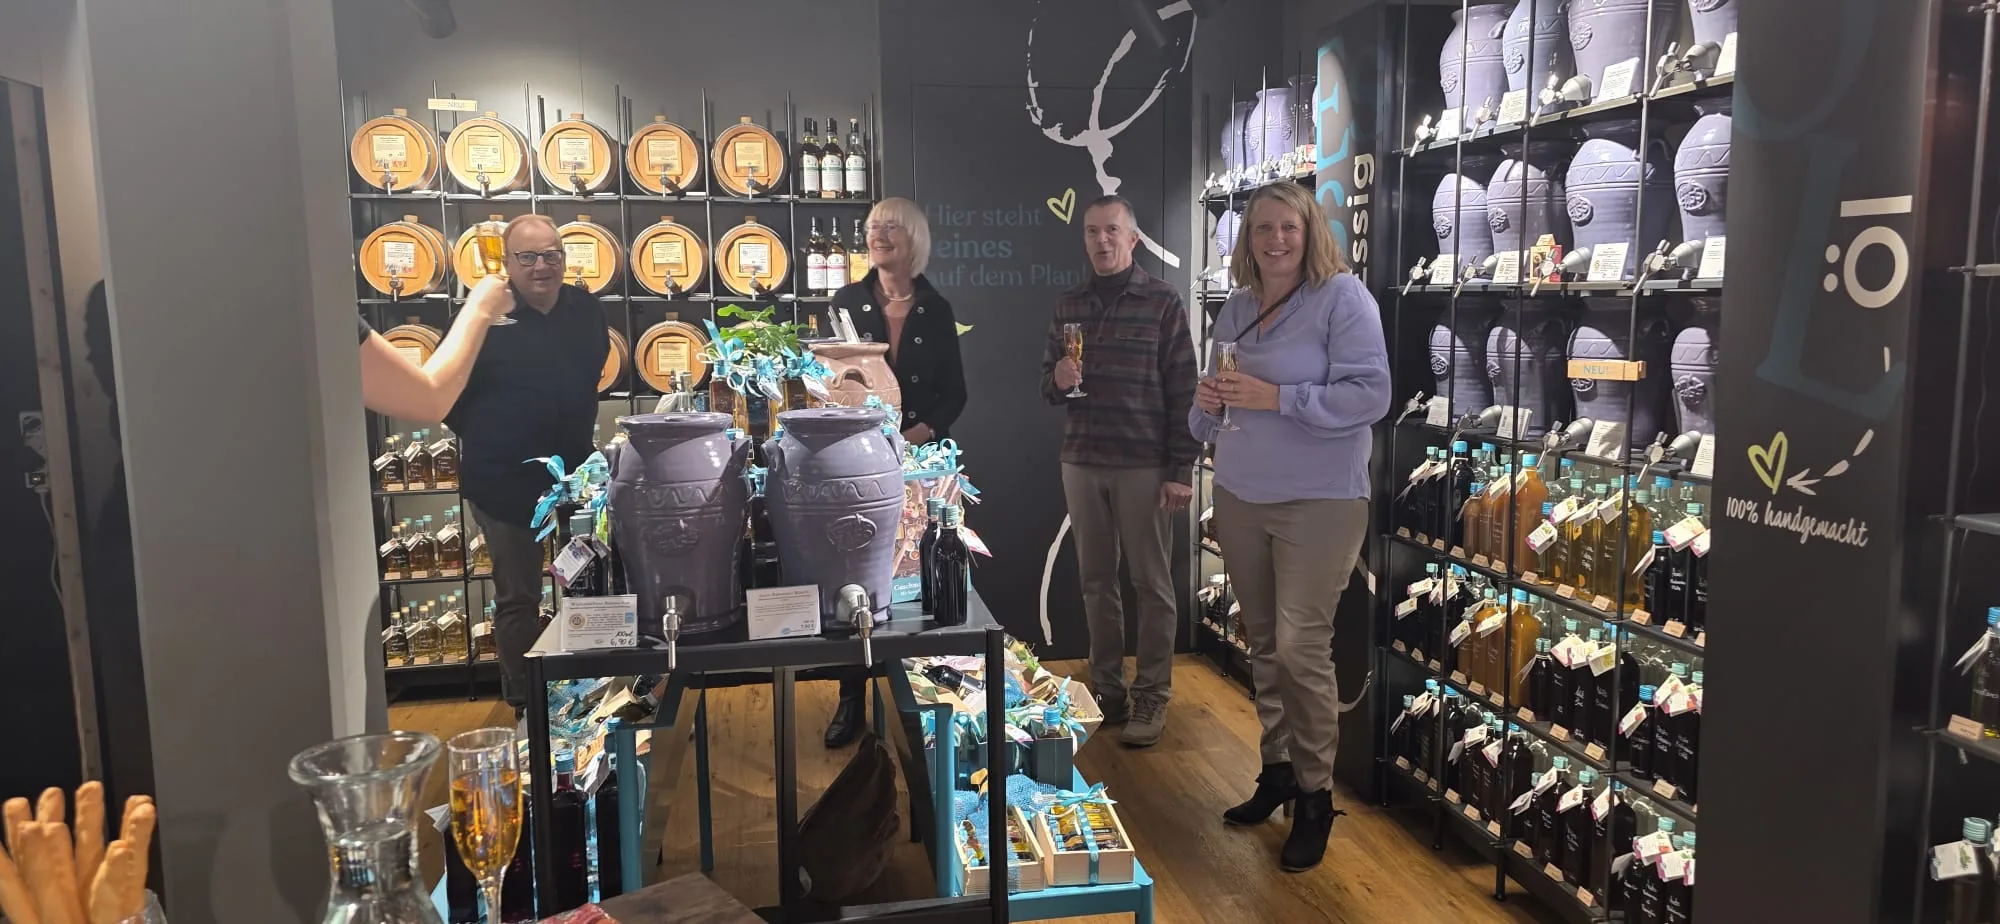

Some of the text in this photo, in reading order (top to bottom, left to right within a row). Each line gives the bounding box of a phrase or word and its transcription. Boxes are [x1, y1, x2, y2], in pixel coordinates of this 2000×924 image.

[924, 202, 1042, 227] Hier steht
[931, 233, 1013, 259] eines
[1823, 195, 1913, 309] Öl
[970, 264, 1023, 287] dem
[1584, 365, 1609, 375] NEU!
[1726, 496, 1869, 547] 100% handgemacht
